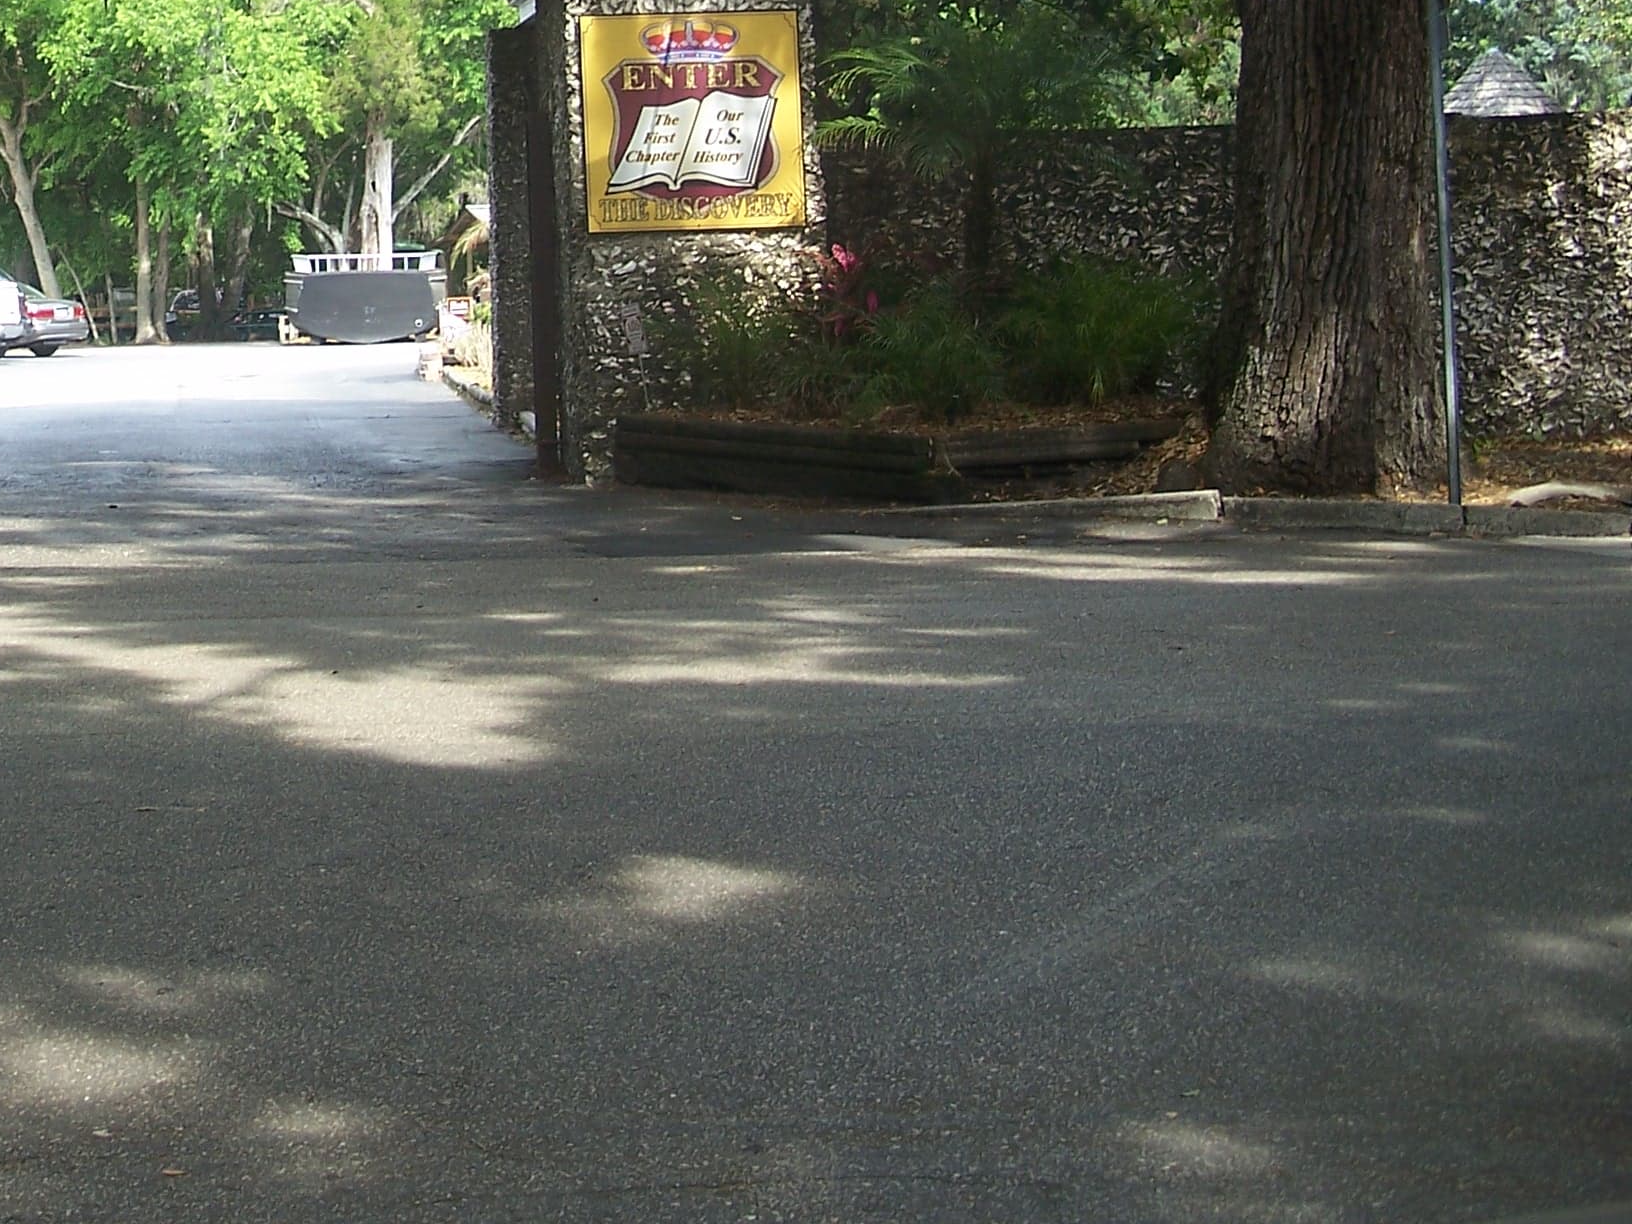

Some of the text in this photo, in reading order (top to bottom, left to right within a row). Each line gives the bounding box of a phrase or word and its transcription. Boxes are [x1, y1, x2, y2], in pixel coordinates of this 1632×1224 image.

[620, 61, 761, 91] ENTER
[654, 113, 680, 127] The
[716, 109, 745, 122] Our
[643, 131, 677, 145] First
[704, 126, 742, 146] U.S.
[625, 149, 681, 166] Chapter
[692, 150, 745, 166] History
[598, 192, 793, 223] THE DISCOVERY
